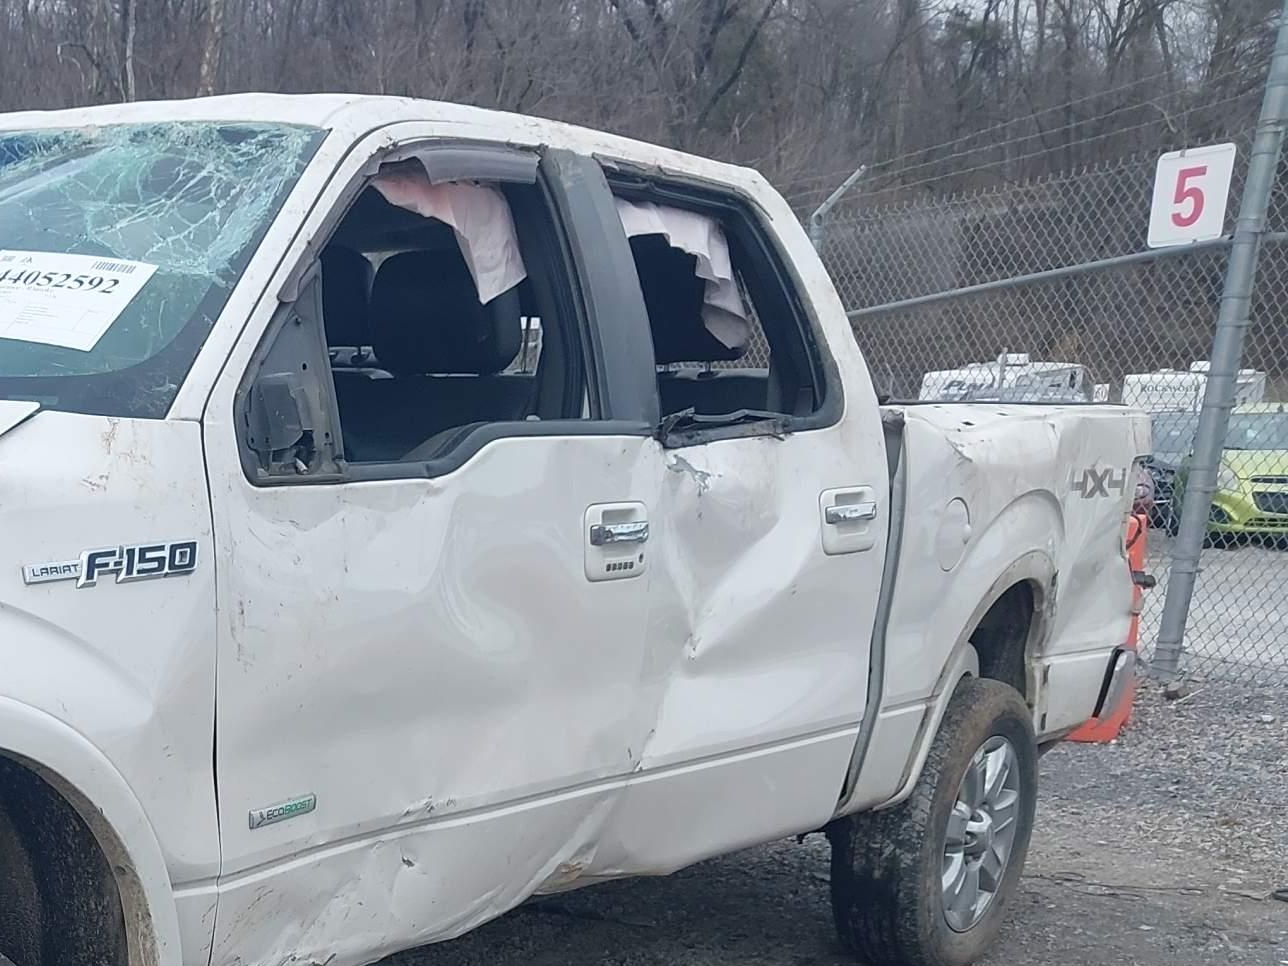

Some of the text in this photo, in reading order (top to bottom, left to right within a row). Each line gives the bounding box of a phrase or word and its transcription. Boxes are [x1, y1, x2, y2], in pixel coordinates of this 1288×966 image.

[1170, 165, 1208, 228] 5
[31, 540, 198, 584] LARIAT F-150
[266, 798, 313, 821] ECOBOOST
